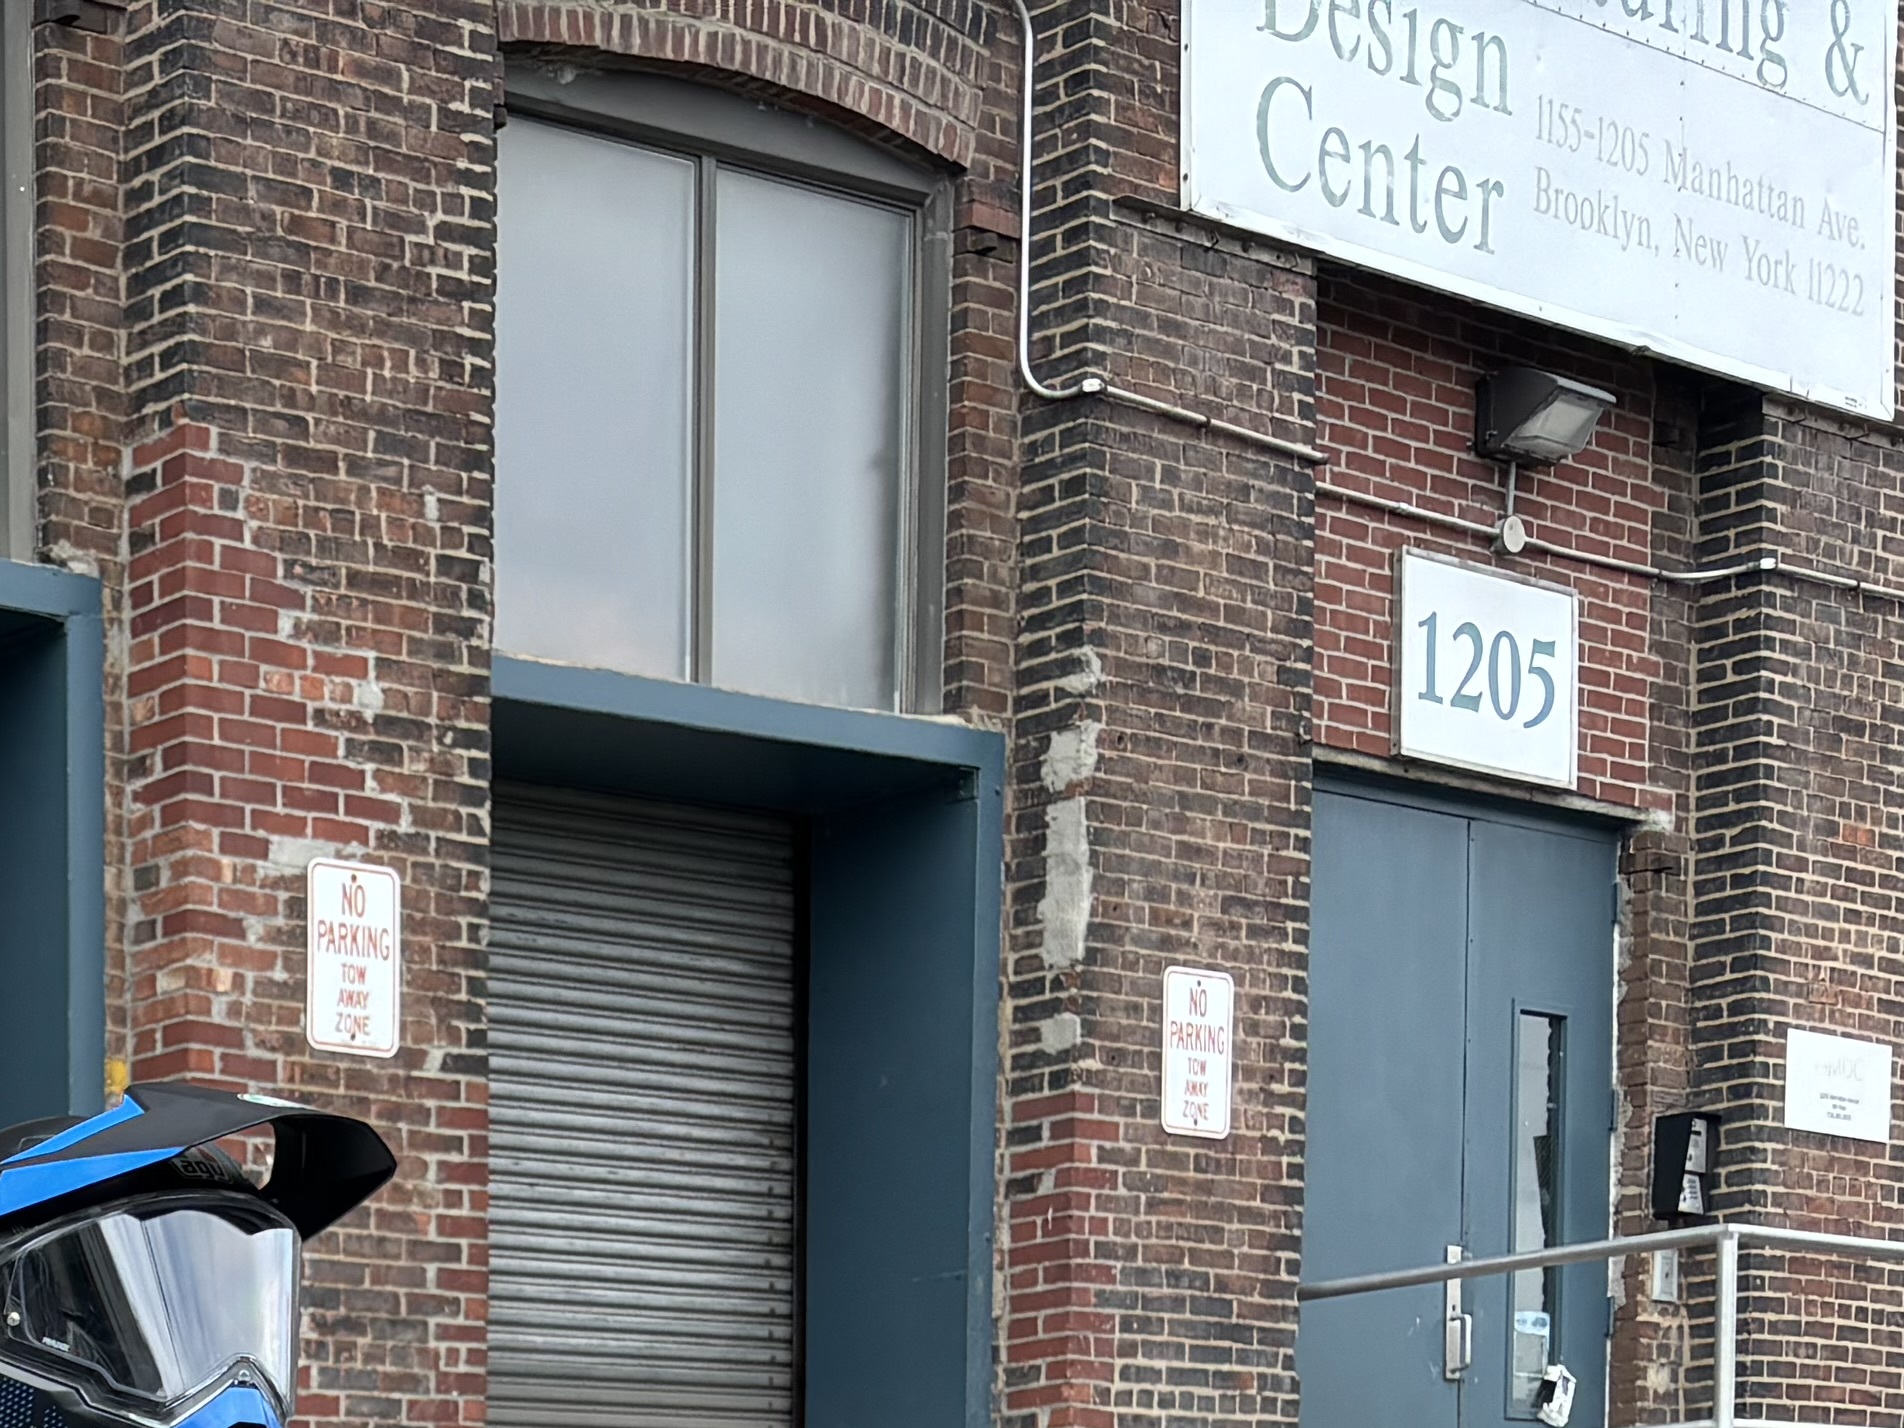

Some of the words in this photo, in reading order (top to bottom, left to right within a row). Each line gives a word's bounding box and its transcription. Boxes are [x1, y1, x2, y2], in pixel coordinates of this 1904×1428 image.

[1824, 0, 1870, 106] &
[1256, 75, 1505, 256] Center
[1535, 93, 1650, 177] 1155-1205
[1663, 138, 1806, 230] Manhattan
[1817, 195, 1867, 250] Ave.
[1533, 165, 1660, 257] Brooklyn,
[1672, 212, 1729, 273] New
[1741, 234, 1797, 296] York
[1807, 257, 1865, 317] 11222
[1417, 611, 1557, 729] 1205
[340, 882, 366, 918] NO
[317, 919, 391, 962] PARKING
[340, 962, 367, 986] TOW
[336, 987, 370, 1011] AWAY
[1188, 986, 1208, 1018] NO
[334, 1011, 371, 1036] ZONE
[1169, 1020, 1226, 1056] PARKING
[1187, 1057, 1208, 1077] TOW
[1184, 1078, 1209, 1098] AWAY
[1182, 1100, 1210, 1121] ZONE
